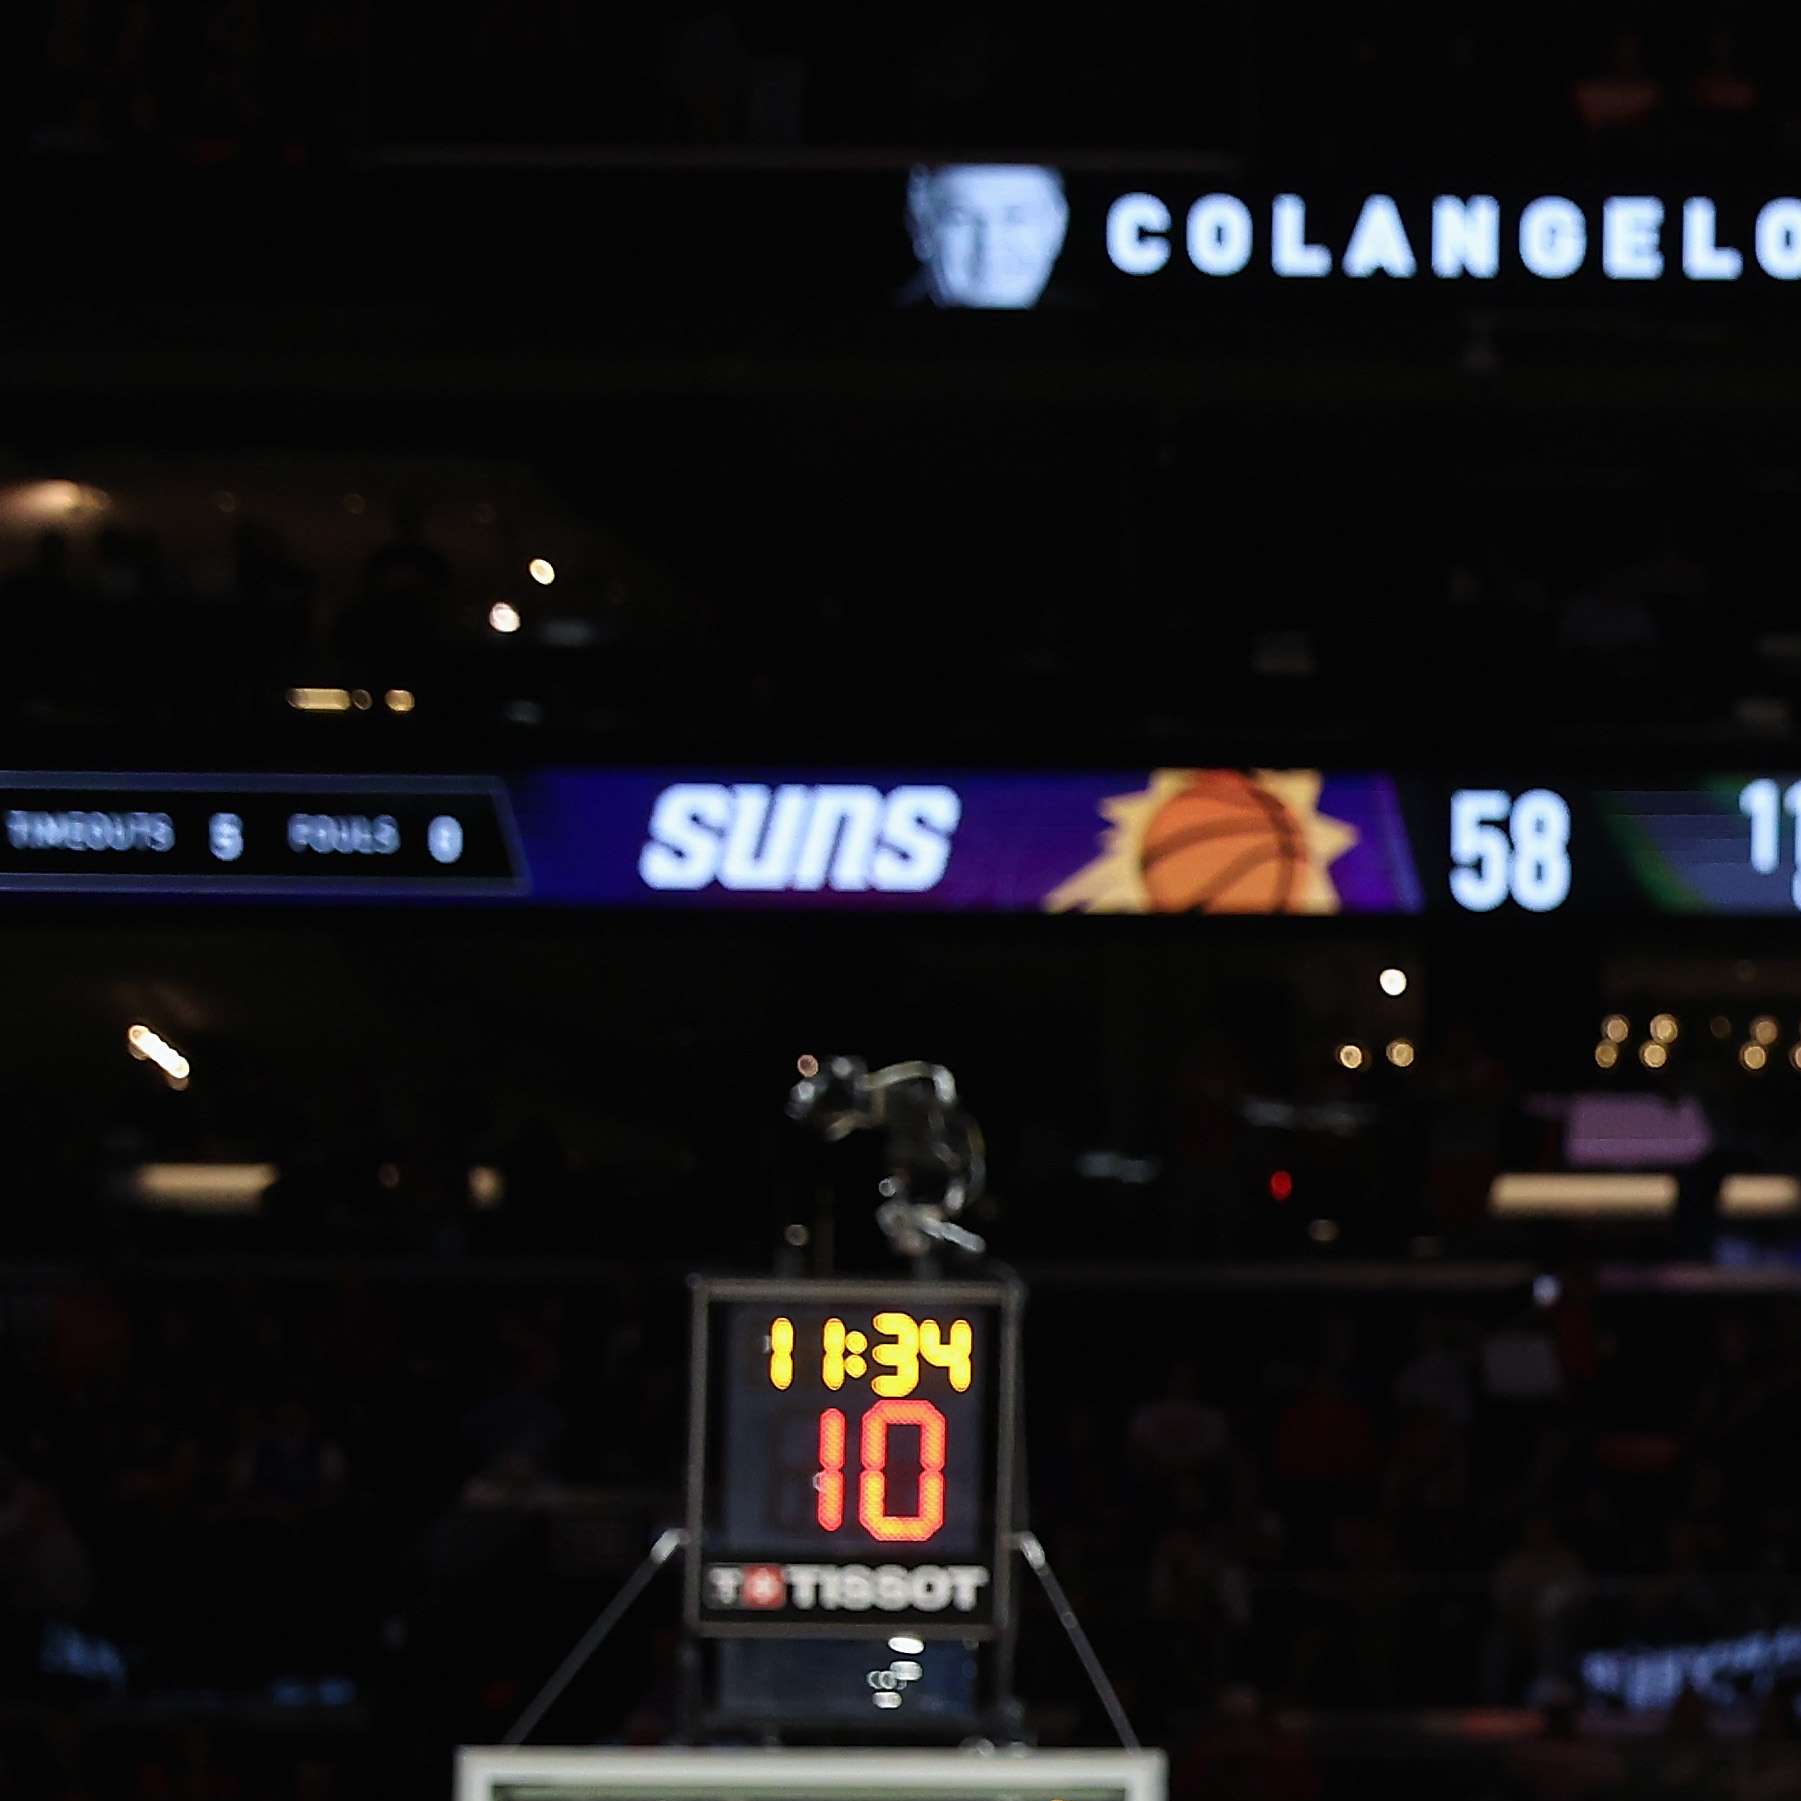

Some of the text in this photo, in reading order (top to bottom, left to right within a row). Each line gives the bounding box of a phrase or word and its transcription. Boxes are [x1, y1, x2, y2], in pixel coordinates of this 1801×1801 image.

[288, 814, 463, 863] FOULS 0
[640, 784, 961, 891] SUNS
[1449, 789, 1571, 912] 58
[768, 1311, 974, 1399] 11:34
[816, 1399, 946, 1543] 10
[786, 1564, 989, 1612] TISSOT
